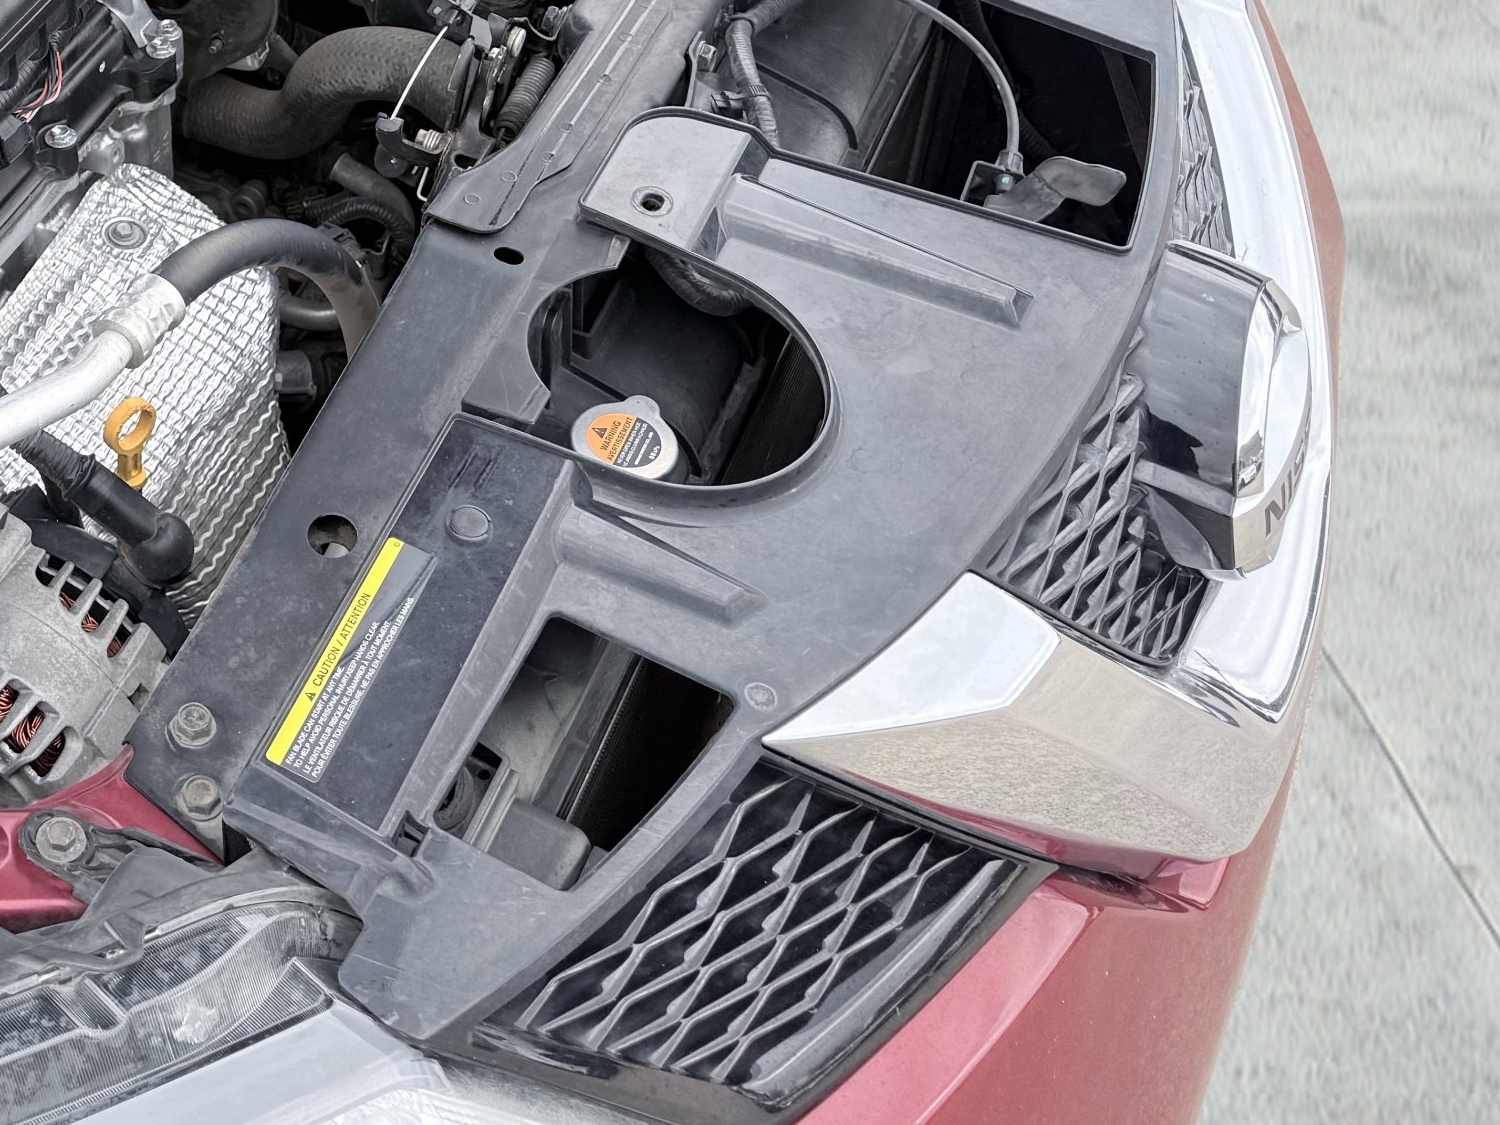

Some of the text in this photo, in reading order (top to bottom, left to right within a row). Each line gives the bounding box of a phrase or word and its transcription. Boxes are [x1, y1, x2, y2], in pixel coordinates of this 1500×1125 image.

[600, 420, 621, 451] WARNING
[606, 417, 633, 461] AVERTISSEMENT
[394, 614, 405, 626] LES
[313, 647, 340, 687] CAUTION
[340, 593, 371, 640] ATTENTION
[376, 626, 399, 660] APPROCHER
[365, 645, 377, 661] TOUT
[371, 658, 380, 669] EN
[345, 665, 367, 697] DÉMARRER
[364, 667, 376, 680] PAS
[325, 680, 337, 693] ANY
[360, 678, 369, 689] NE
[294, 759, 303, 768] TO
[300, 743, 313, 760] HELP
[309, 725, 323, 744] AVOID
[319, 694, 340, 725] PERSONAL
[354, 641, 369, 661] HANDS
[321, 691, 330, 701] AT
[340, 695, 350, 705] DE
[312, 701, 325, 719] START
[329, 705, 345, 728] RISQUE
[303, 717, 315, 733] CAN
[333, 721, 347, 740] TOUTE
[293, 732, 308, 752] BLADE
[307, 727, 333, 766] VENTILATEUR
[320, 739, 337, 760] ÉVITER
[285, 751, 297, 764] FAN
[303, 764, 312, 774] LE
[312, 760, 326, 778] POUR
